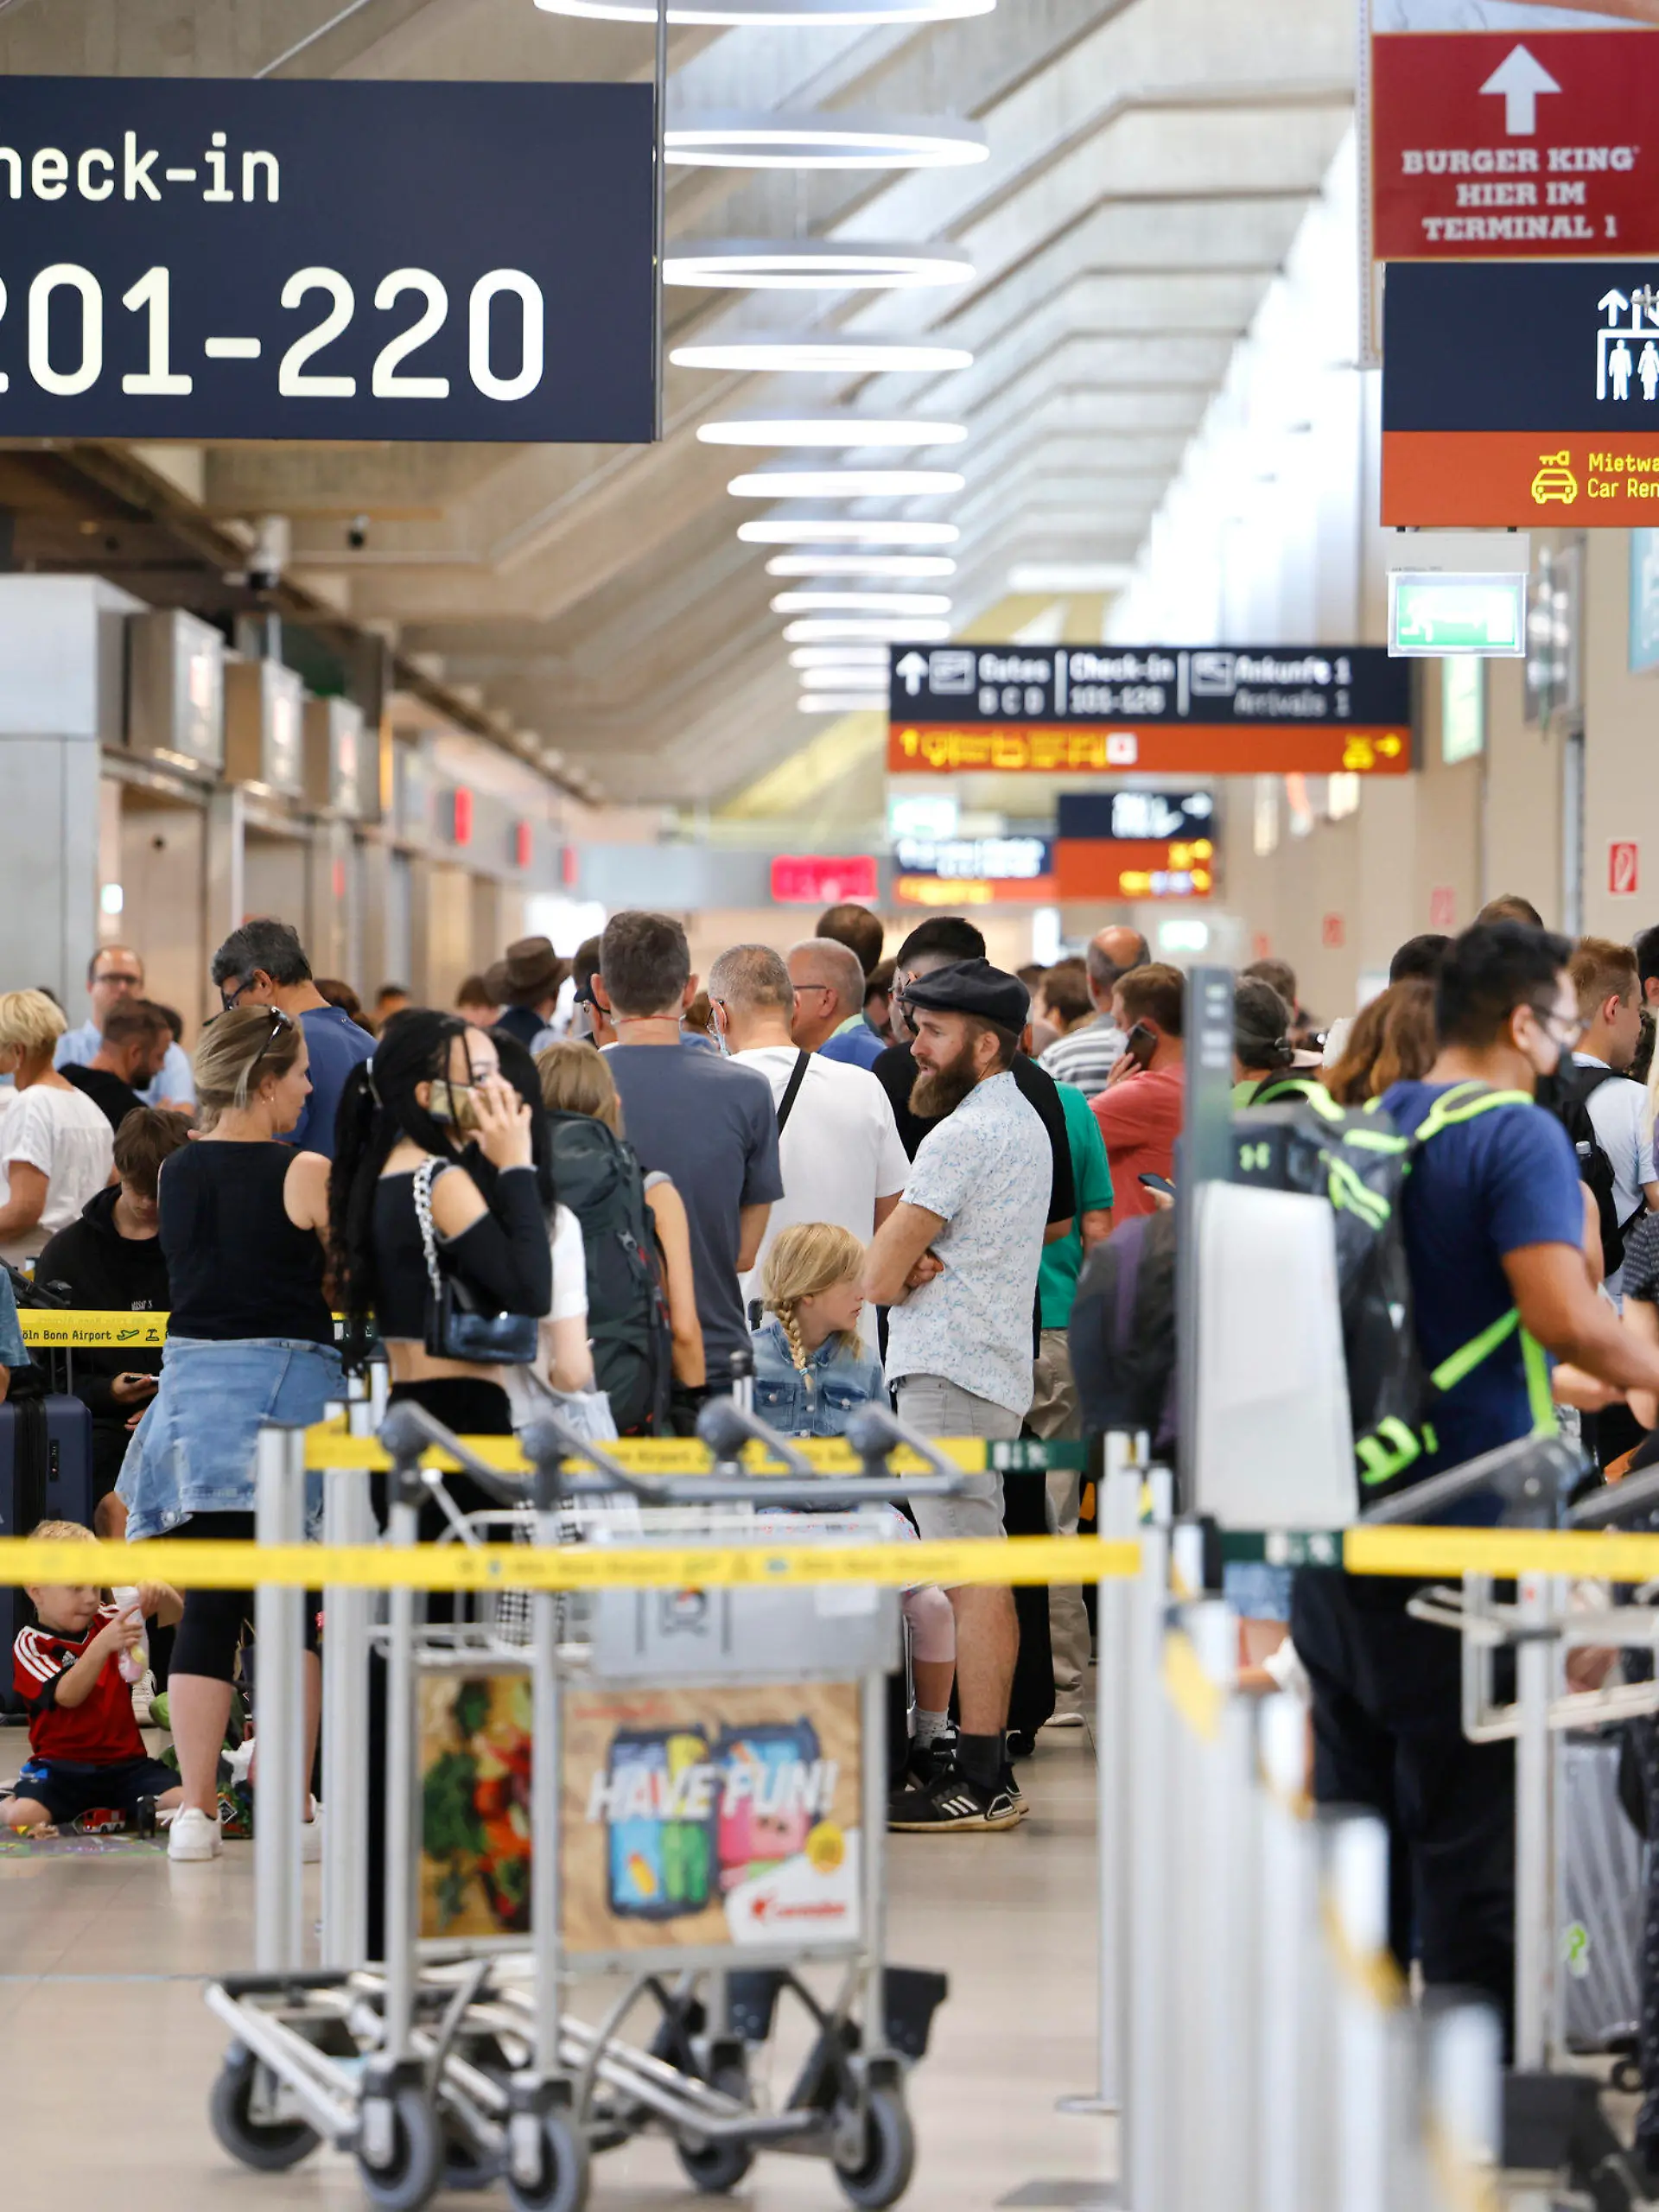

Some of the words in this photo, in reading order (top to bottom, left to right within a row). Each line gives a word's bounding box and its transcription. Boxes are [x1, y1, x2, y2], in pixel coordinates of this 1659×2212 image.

[1402, 149, 1539, 174] BURGER
[1548, 147, 1635, 172] KING
[1456, 182, 1537, 207] HIER
[1546, 181, 1586, 205] IM
[1422, 215, 1593, 241] TERMINAL
[1605, 215, 1618, 238] 1
[0, 263, 544, 402] 01-220
[1588, 453, 1659, 474] Mietwa
[1587, 477, 1619, 499] Car
[1627, 477, 1659, 499] Ren
[1069, 652, 1176, 683] Check-in
[1236, 654, 1332, 685] Ankunft
[22, 1330, 40, 1340] öln
[43, 1330, 68, 1341] Bonn
[72, 1330, 111, 1343] Airport
[587, 1764, 715, 1822] HAVE
[722, 1759, 839, 1817] FUN!
